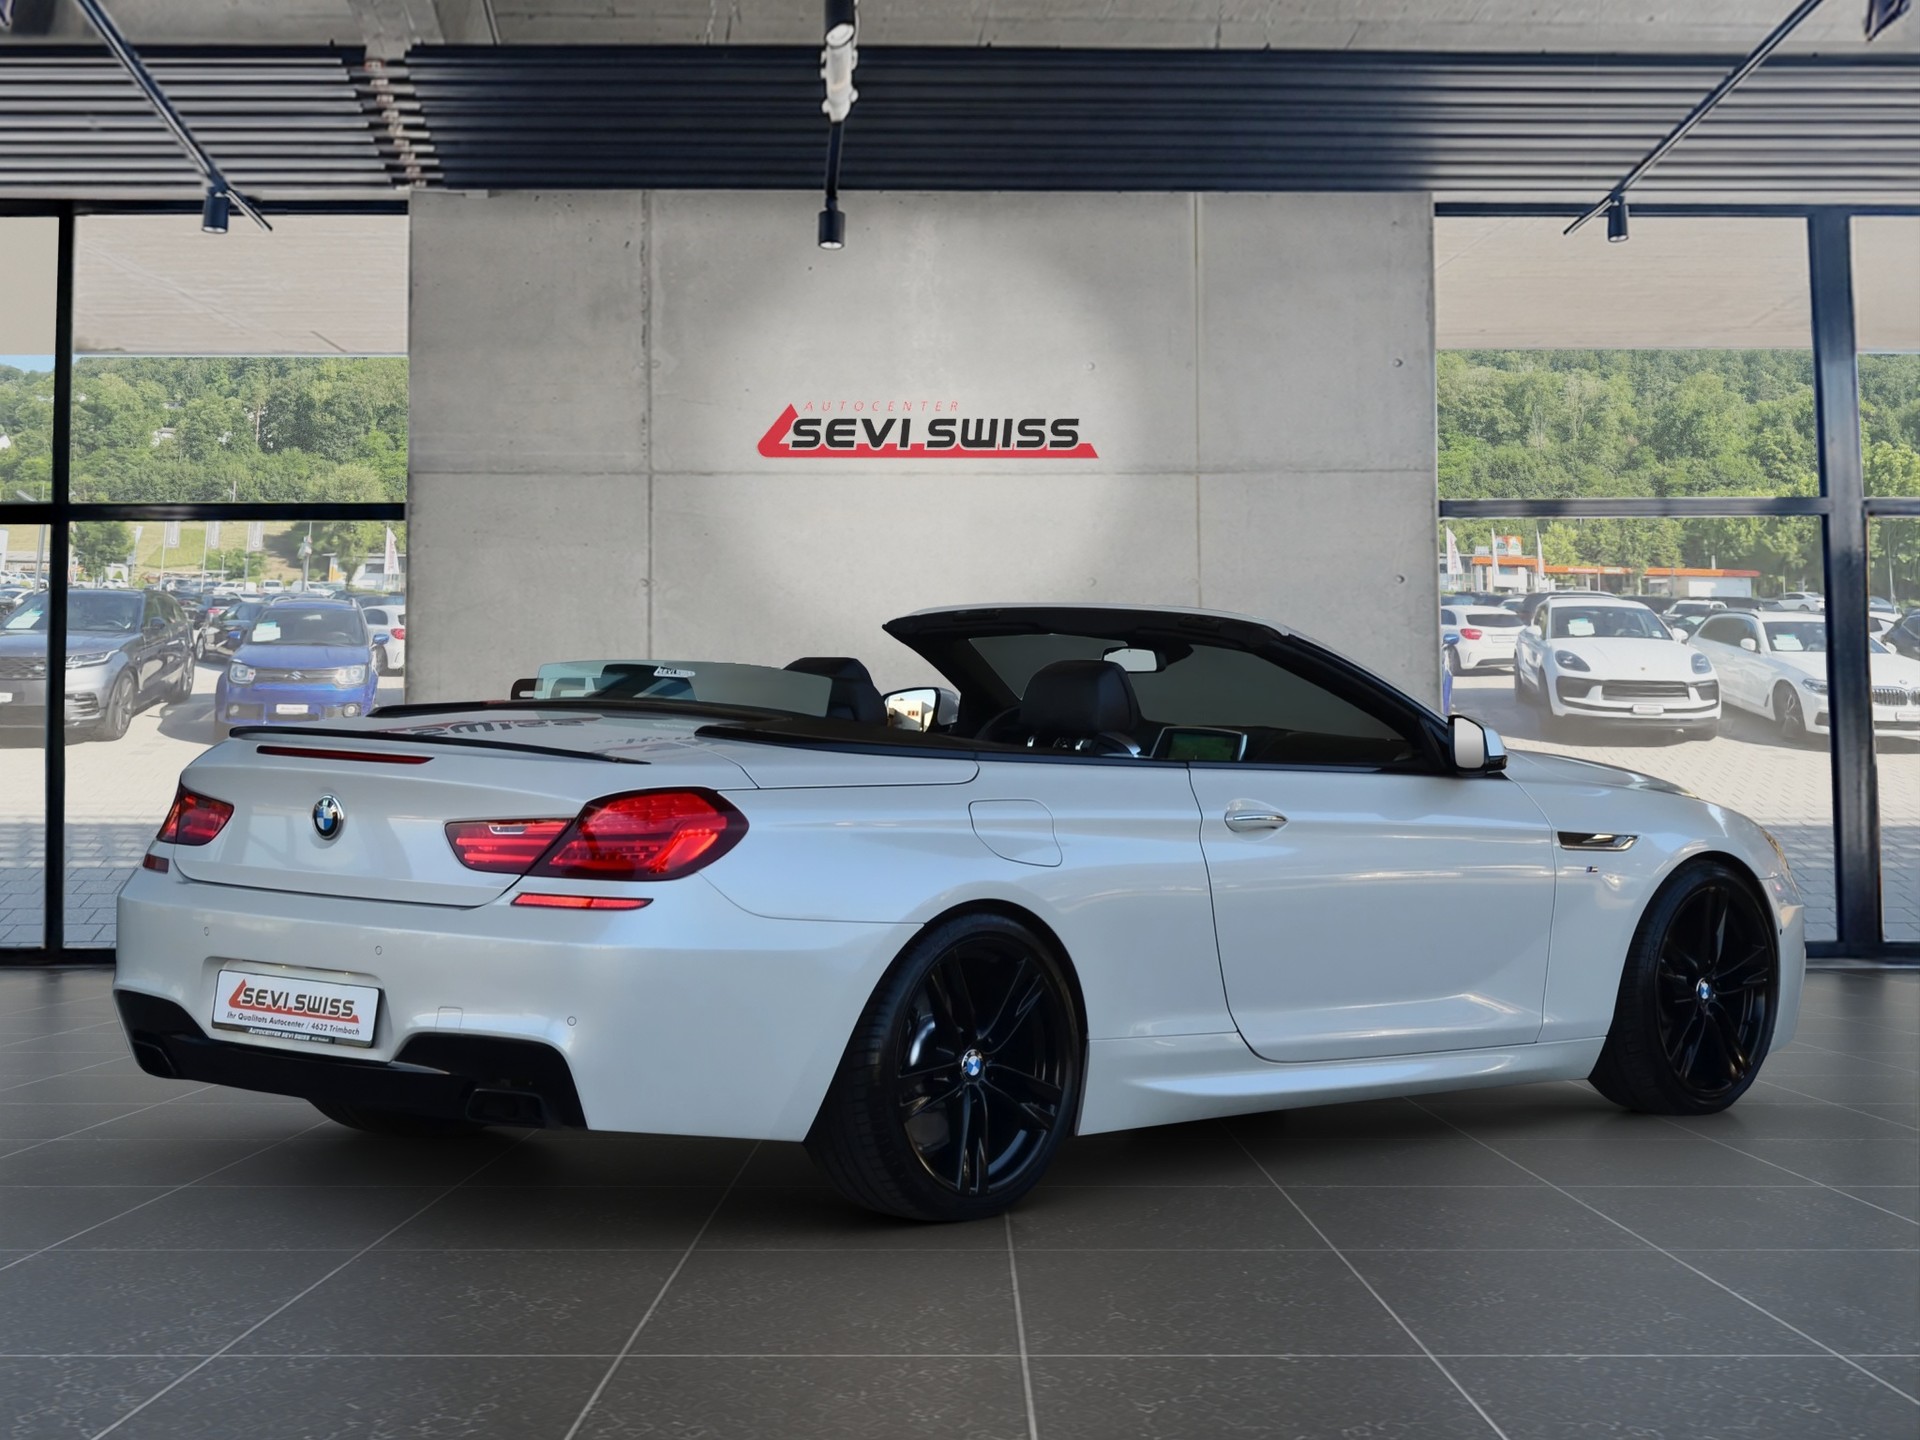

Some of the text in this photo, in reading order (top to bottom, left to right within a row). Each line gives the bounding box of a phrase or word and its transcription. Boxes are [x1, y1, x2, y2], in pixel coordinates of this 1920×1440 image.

[803, 400, 960, 412] AUTOCENTER
[791, 418, 1080, 448] SEVI SWISS
[241, 987, 355, 1017] SEVI SWISS
[226, 1011, 237, 1019] Ihr
[269, 1017, 305, 1030] Autocenter
